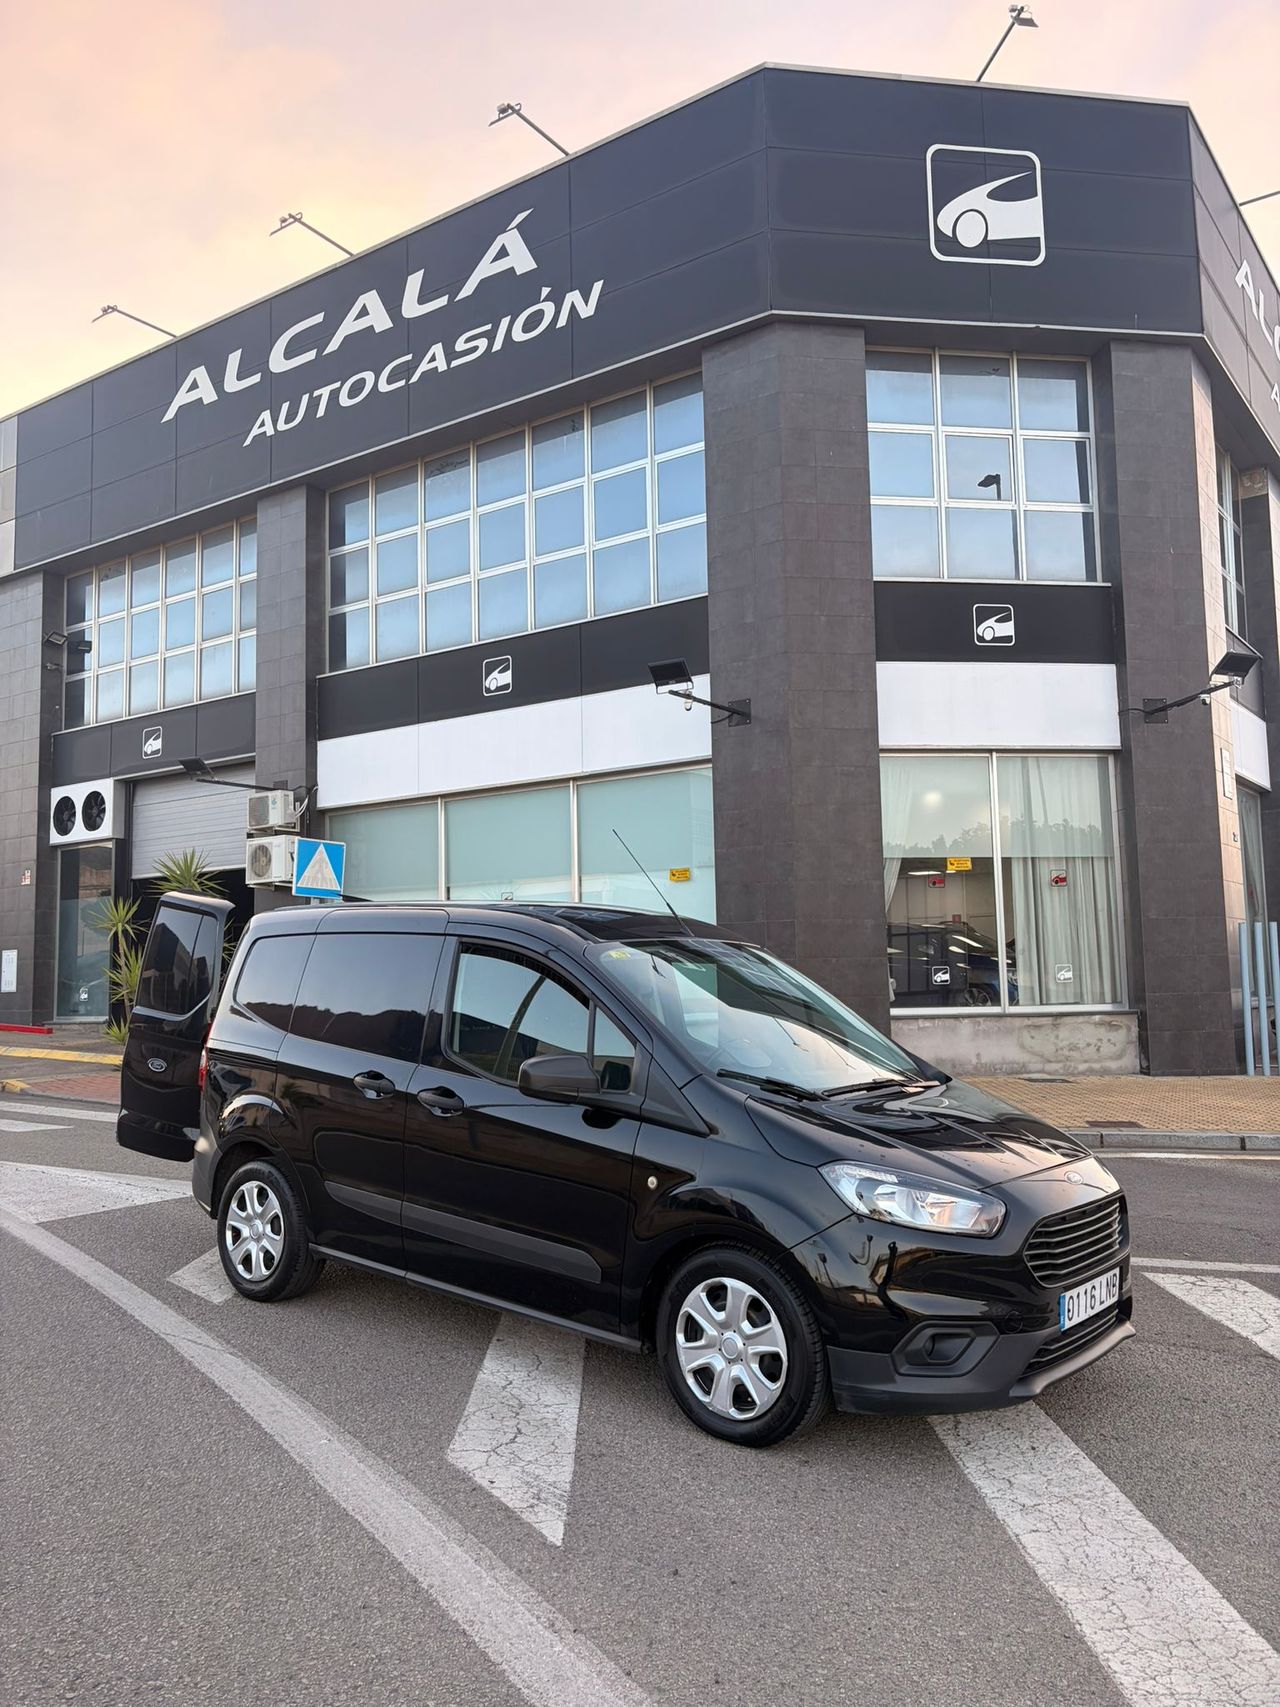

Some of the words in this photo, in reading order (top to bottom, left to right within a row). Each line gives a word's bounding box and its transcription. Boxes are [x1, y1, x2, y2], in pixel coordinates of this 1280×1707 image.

[161, 207, 538, 424] ALCALÁ
[243, 279, 604, 447] AUTOCASIÓN
[1067, 1284, 1097, 1322] 0116
[1099, 1272, 1118, 1306] LNB
